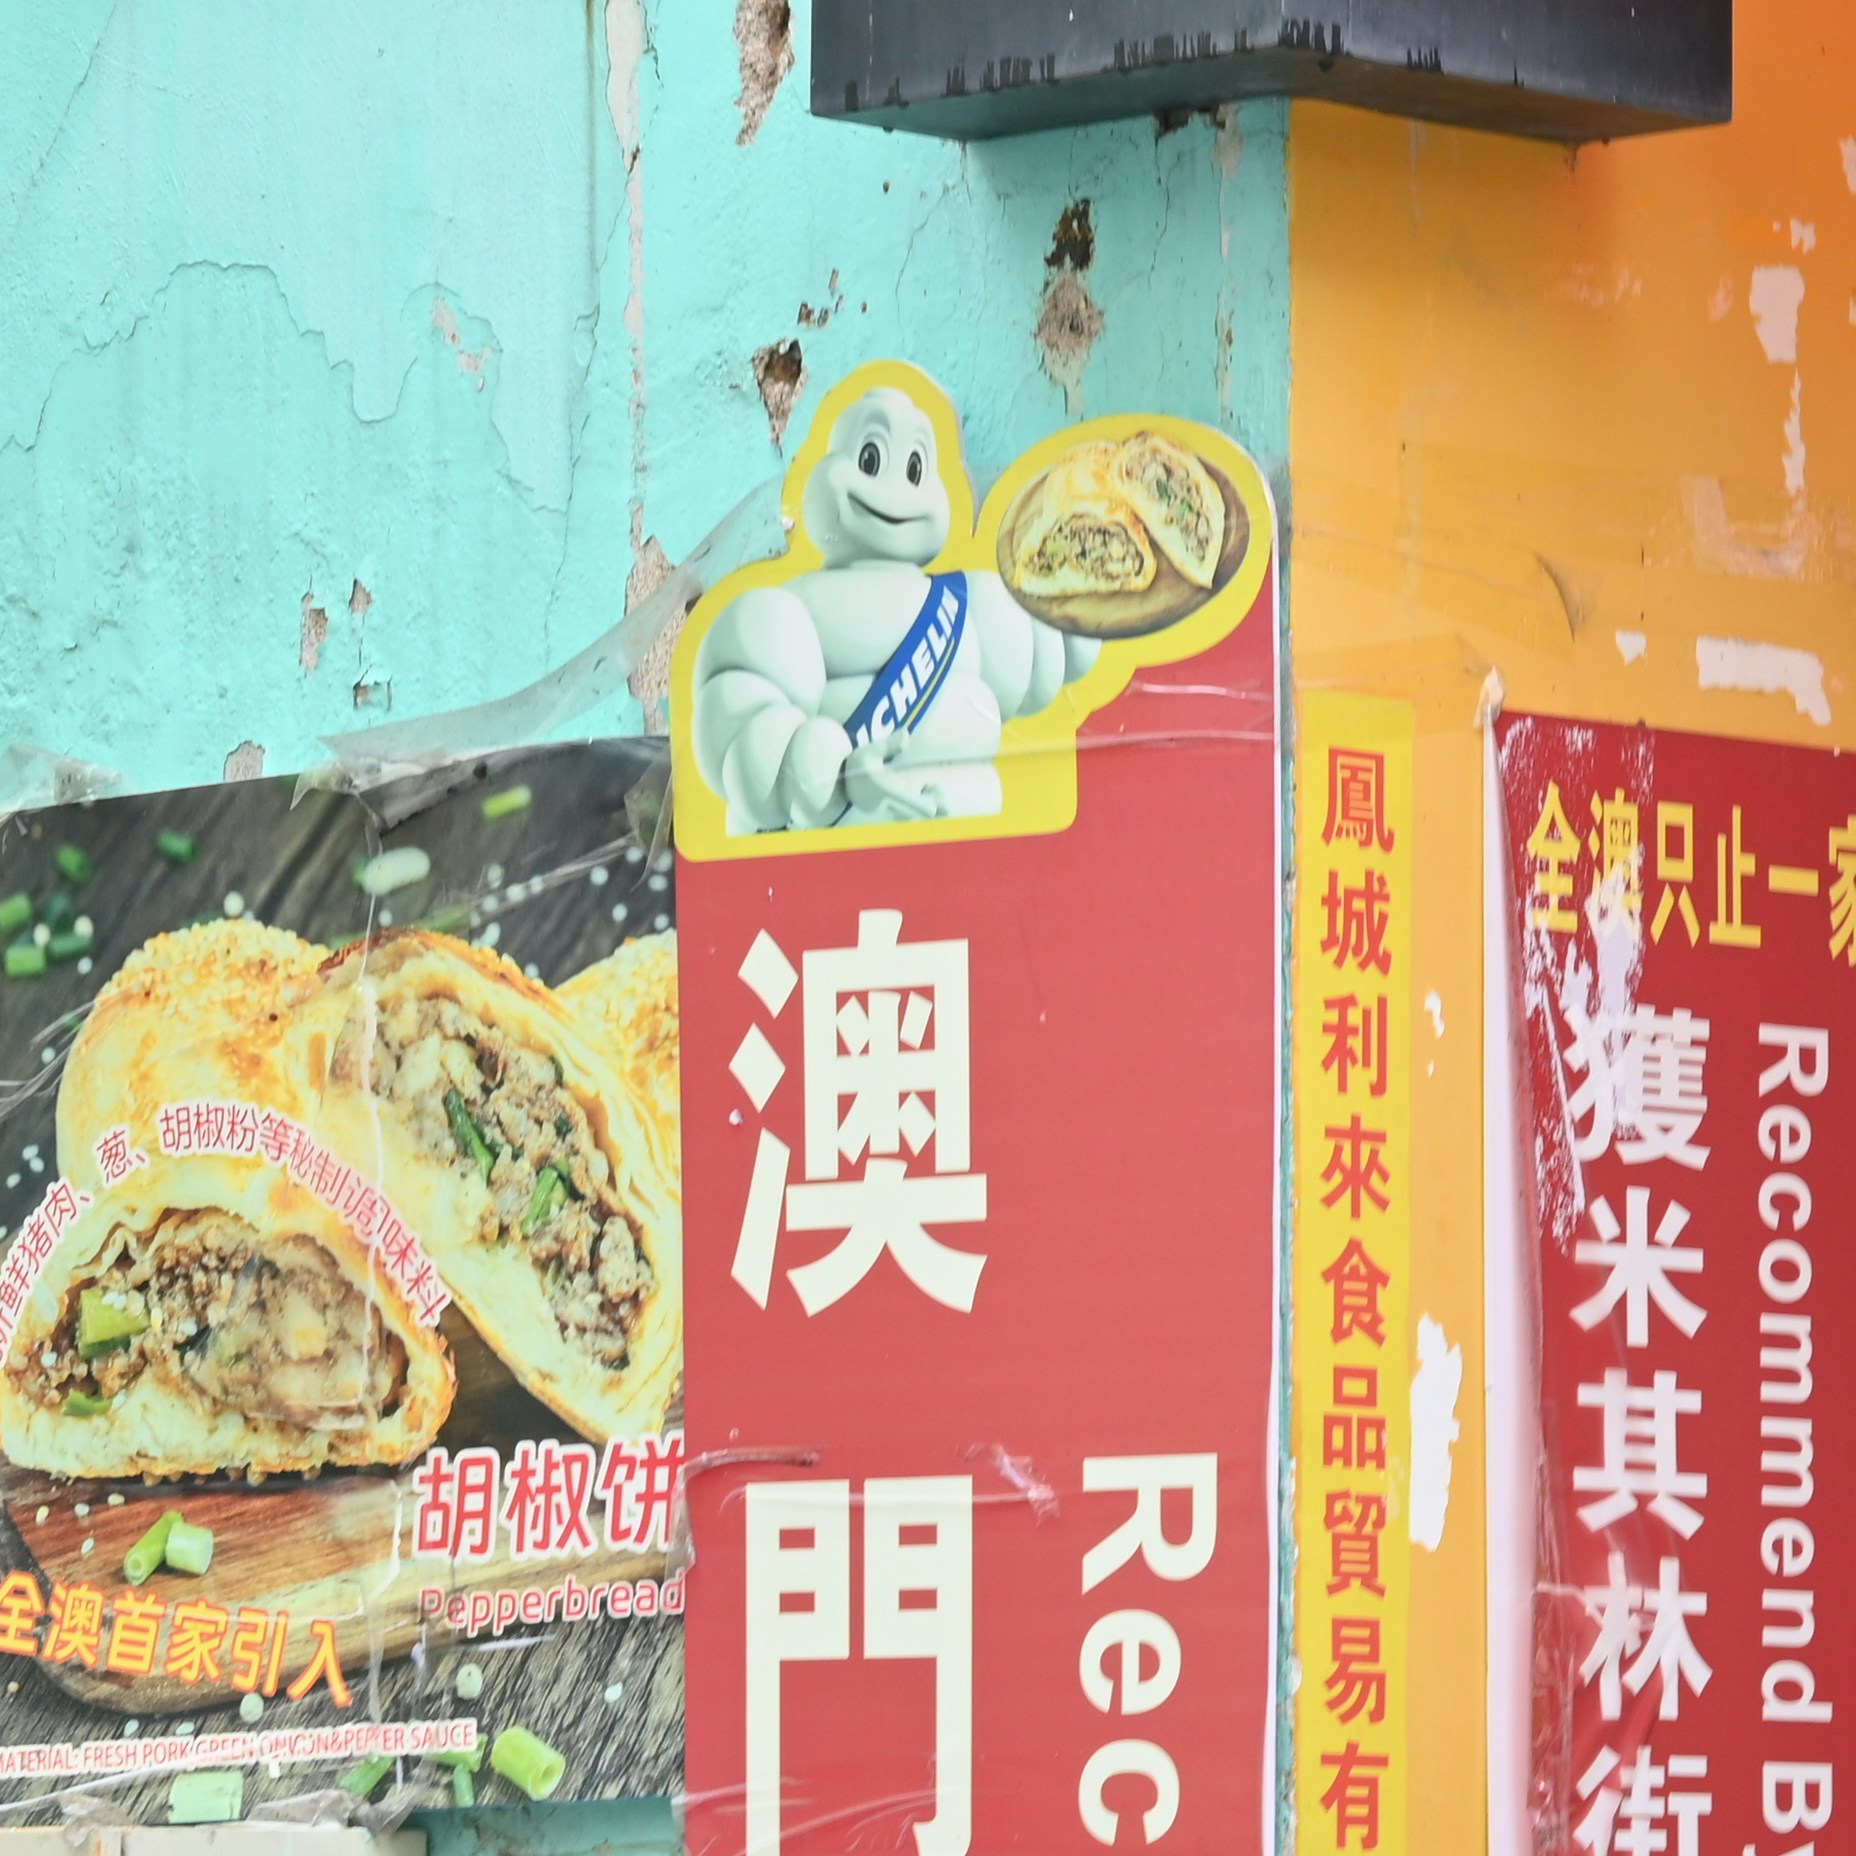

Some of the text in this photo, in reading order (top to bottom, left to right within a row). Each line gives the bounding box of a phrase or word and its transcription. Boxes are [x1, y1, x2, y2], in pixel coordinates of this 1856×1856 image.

[855, 584, 960, 748] ICHELIN
[417, 1436, 686, 1558] 胡椒饼
[727, 908, 988, 1856] 澳門
[1320, 746, 1396, 1853] 鳳城利來食品貿易有
[1562, 1003, 1713, 1856] 獲米其林街
[1742, 1023, 1834, 1856] Recommend B
[84, 1743, 137, 1770] FRESH
[410, 1722, 474, 1750] SAUCE
[419, 1573, 686, 1635] Pepperbread
